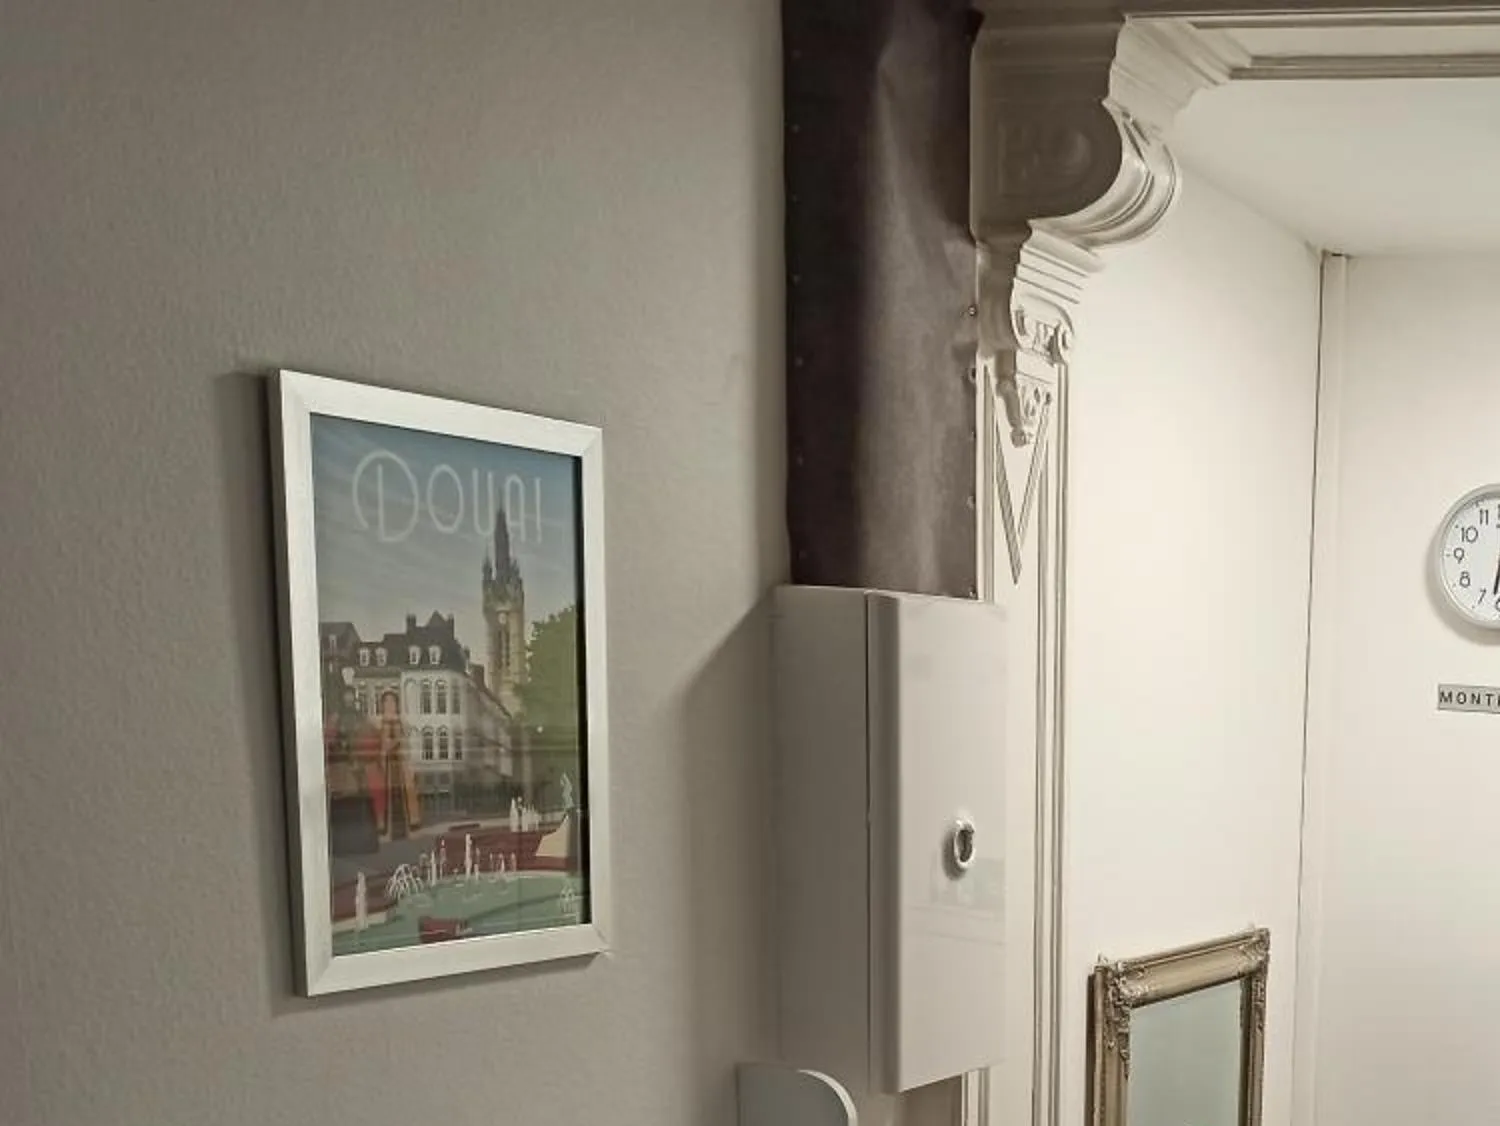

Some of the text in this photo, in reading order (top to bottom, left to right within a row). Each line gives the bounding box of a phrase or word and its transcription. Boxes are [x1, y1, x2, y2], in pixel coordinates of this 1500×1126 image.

[353, 450, 543, 543] DOUAI
[1479, 508, 1489, 526] 11
[1460, 526, 1478, 543] 10
[1453, 547, 1465, 564] 9
[1459, 571, 1471, 588] 8
[1478, 588, 1486, 605] 7
